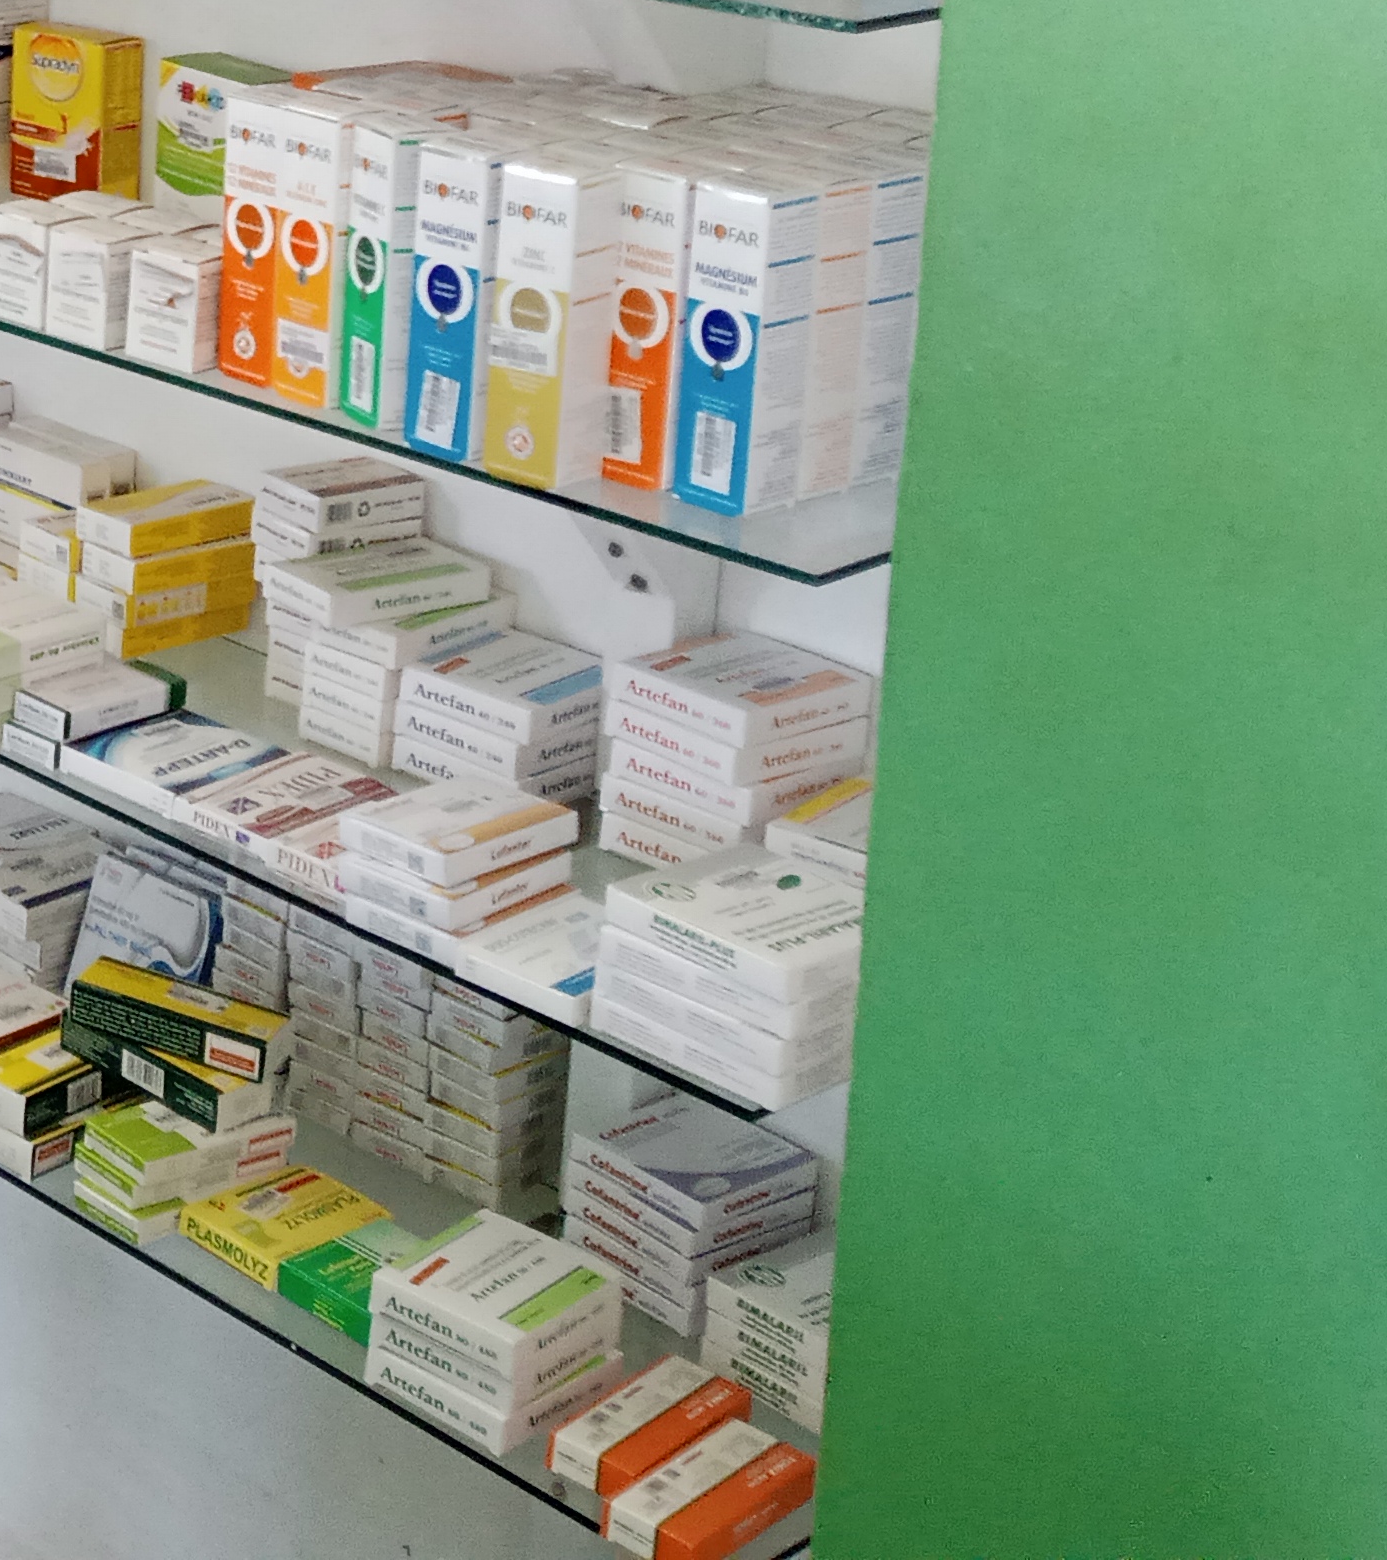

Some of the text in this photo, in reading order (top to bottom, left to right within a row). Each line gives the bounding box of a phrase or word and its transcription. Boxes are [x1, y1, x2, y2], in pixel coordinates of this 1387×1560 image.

[424, 178, 479, 207] BIOFAR
[506, 200, 568, 228] BIOFAR
[698, 219, 759, 248] BIOFAR
[374, 592, 421, 610] Artefan
[413, 683, 476, 717] Artefan
[627, 679, 689, 714] Artefan
[407, 716, 465, 749] Artefan
[621, 717, 680, 752] Artefan
[626, 757, 692, 792] Artefan
[761, 748, 811, 769] Artefan
[615, 791, 681, 828] Artefan
[616, 830, 682, 864] Artefan
[186, 1215, 269, 1281] PLASMOLYZ
[385, 1295, 453, 1337] Artefan
[384, 1329, 453, 1372] Artefan
[379, 1365, 445, 1410] Artefan
